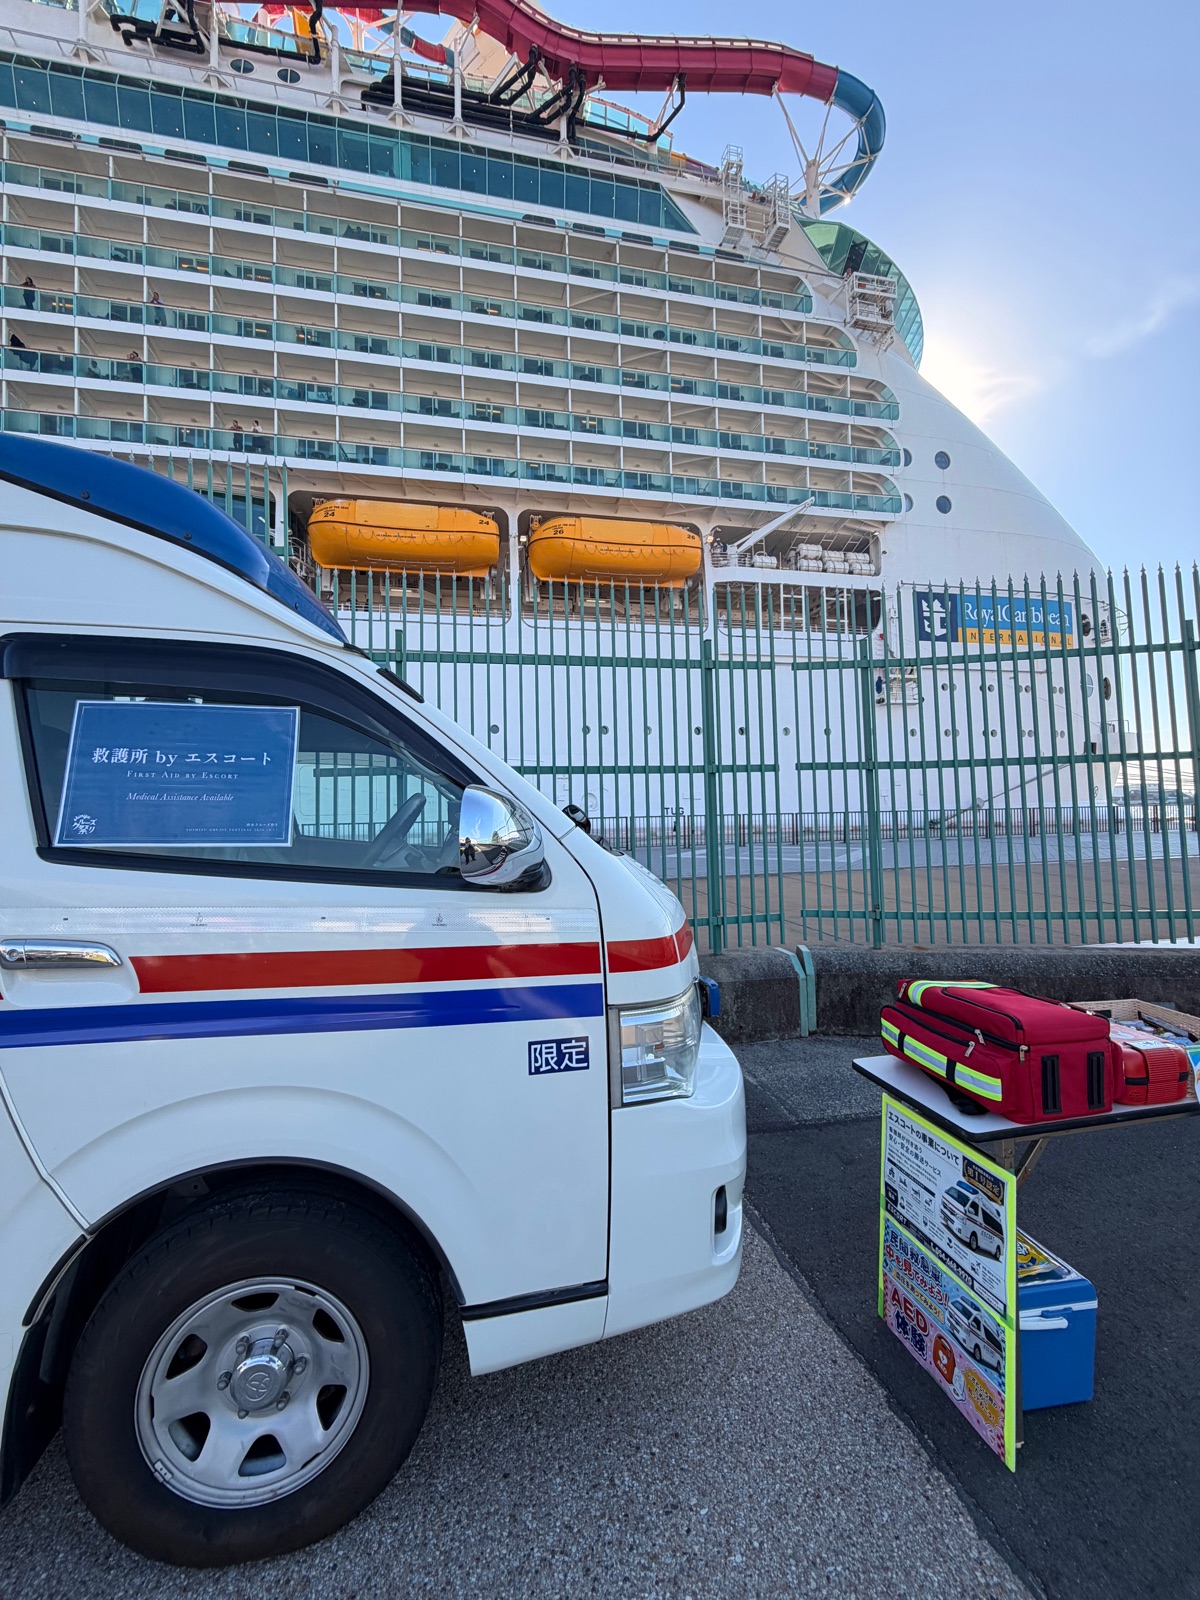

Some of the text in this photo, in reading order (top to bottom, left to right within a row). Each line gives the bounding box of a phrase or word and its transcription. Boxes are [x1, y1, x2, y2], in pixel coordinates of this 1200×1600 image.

[92, 748, 272, 766] 救護所 by エスコート
[126, 792, 234, 802] Medical Assistance Available
[664, 807, 684, 815] TUG
[530, 1040, 588, 1072] 限定
[888, 1111, 960, 1165] エスコートの事業について
[890, 1229, 942, 1287] 民間救急車
[892, 1288, 928, 1334] AED
[895, 1310, 926, 1358] 体験
